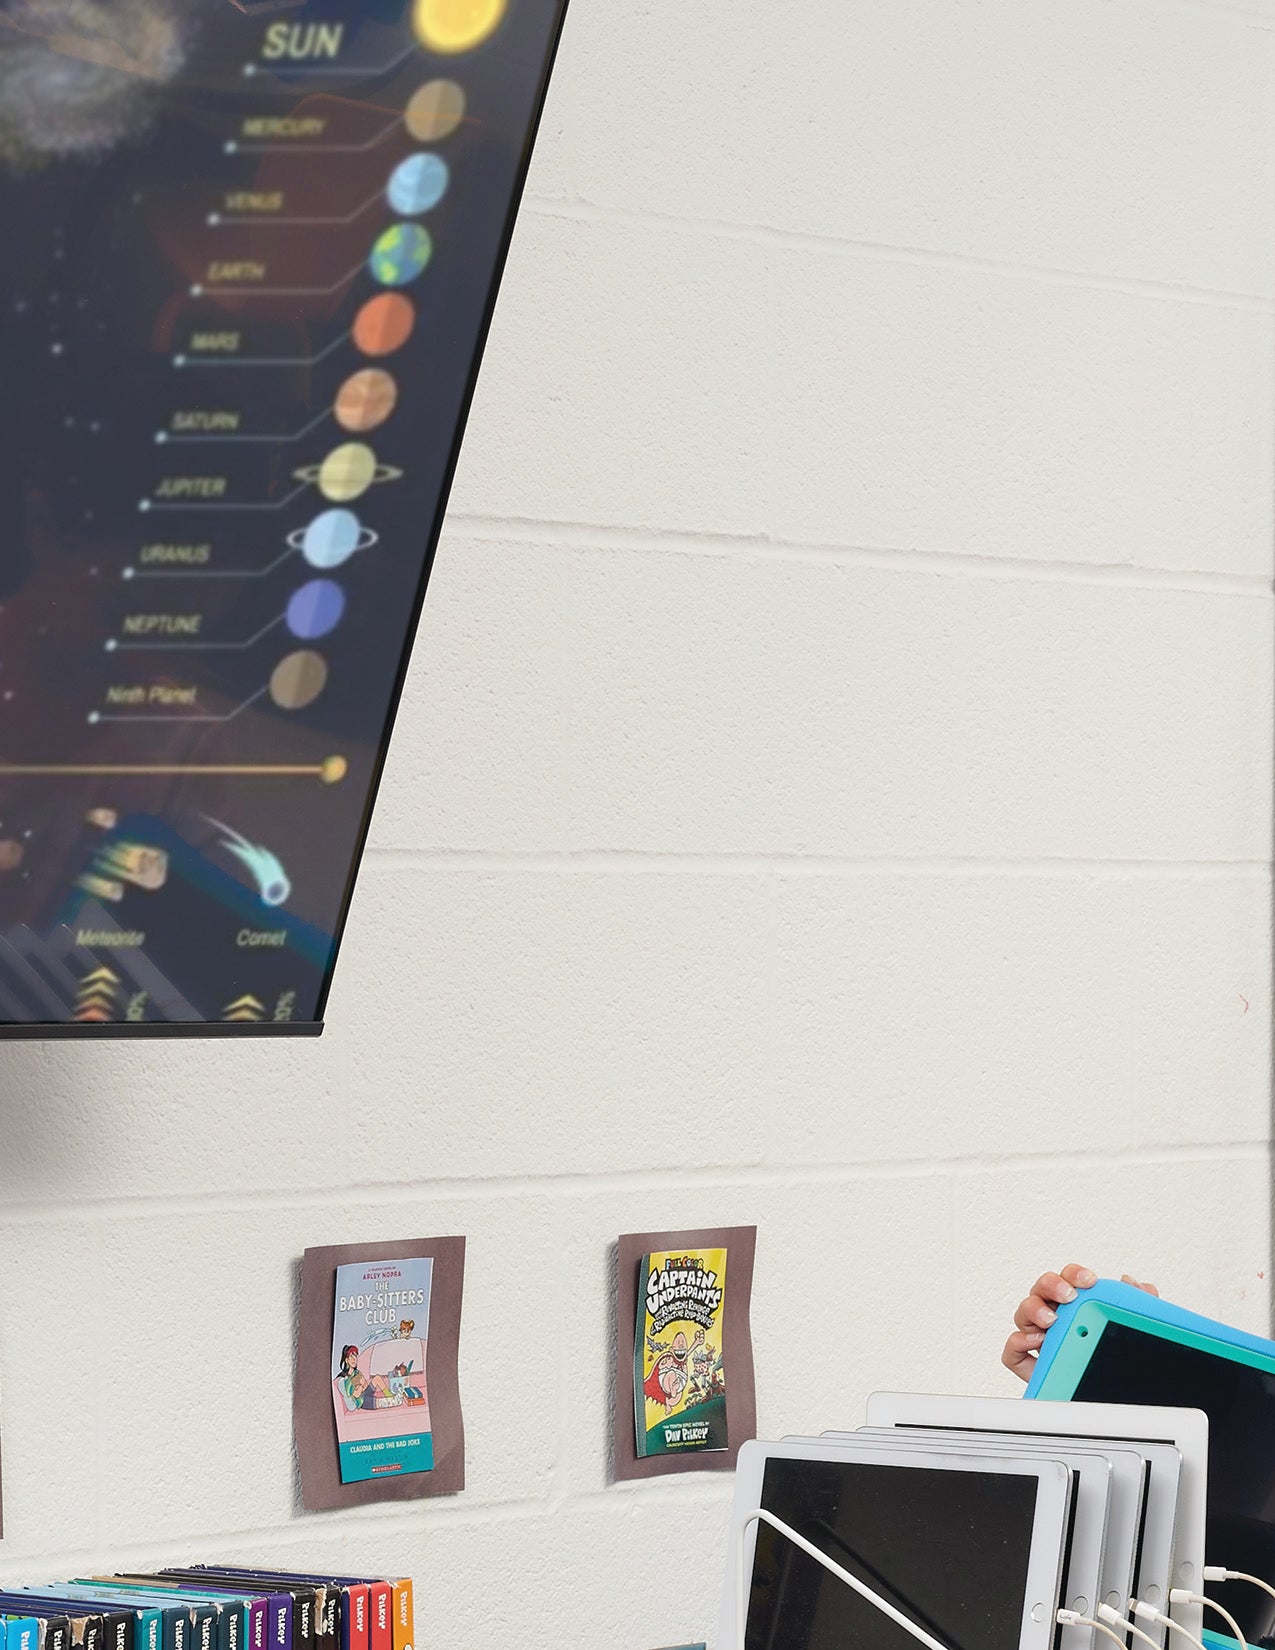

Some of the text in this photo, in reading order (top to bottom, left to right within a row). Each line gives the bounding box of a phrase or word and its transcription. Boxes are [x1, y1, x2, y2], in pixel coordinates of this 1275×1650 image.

[262, 23, 344, 59] SUN
[243, 118, 325, 136] MERCURY
[226, 193, 283, 210] VENUS
[208, 263, 265, 281] EARTH
[192, 333, 240, 351] MARS
[172, 412, 239, 430] SATURN
[155, 477, 226, 496] JUPITER
[141, 545, 210, 563] URANUS
[124, 616, 202, 633] NEPTUNE
[237, 930, 287, 947] Comet
[375, 1281, 390, 1292] THE
[339, 1289, 424, 1312] BABY-SITTERS
[646, 1284, 722, 1314] UNDERPANTS
[365, 1308, 397, 1325] CLUB
